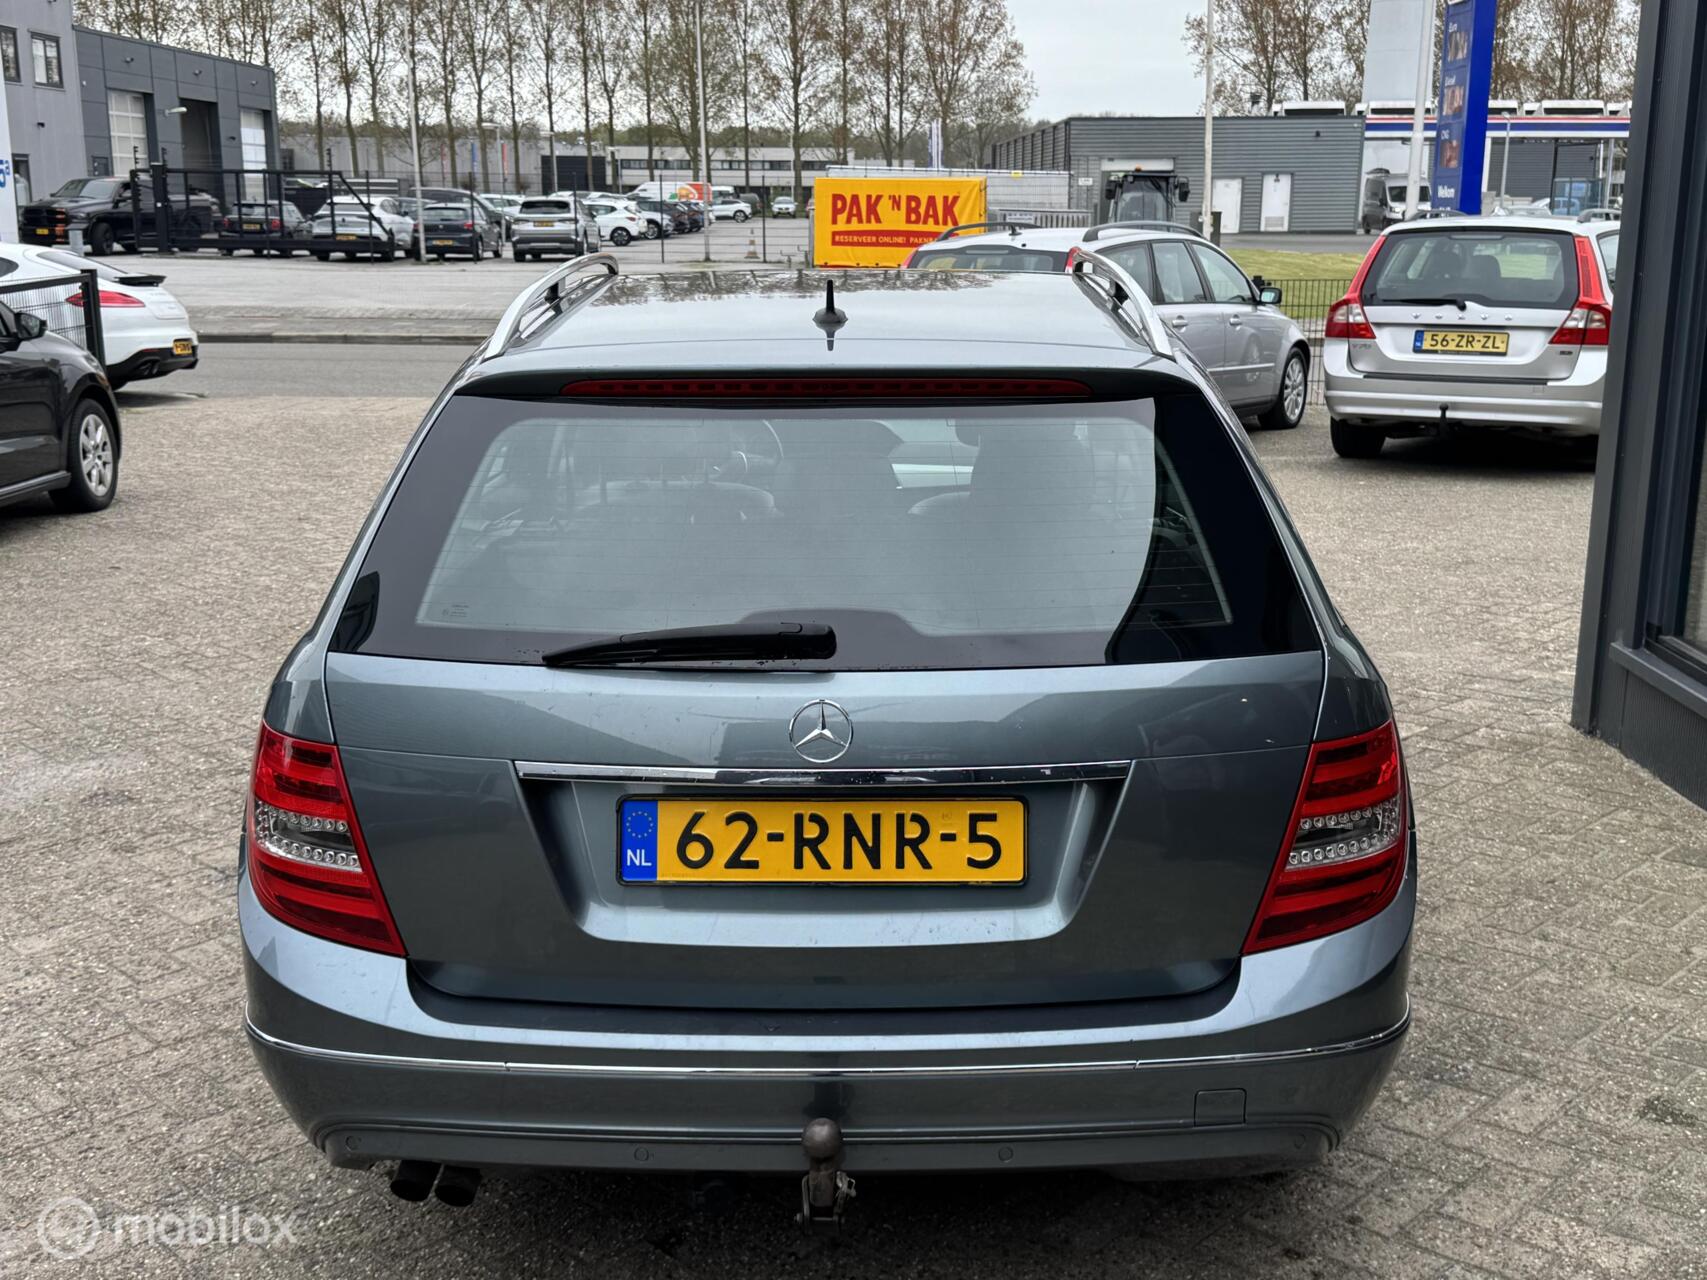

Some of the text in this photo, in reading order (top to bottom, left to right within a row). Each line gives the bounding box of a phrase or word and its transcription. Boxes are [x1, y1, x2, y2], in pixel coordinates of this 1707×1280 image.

[831, 193, 883, 226] PAK
[905, 194, 960, 227] BAK
[834, 234, 877, 243] RESERVEER
[878, 235, 907, 244] ONLINE!
[1429, 333, 1500, 350] 56-ZR-ZL
[676, 811, 1001, 870] 62-RNR-5
[627, 848, 652, 867] NL
